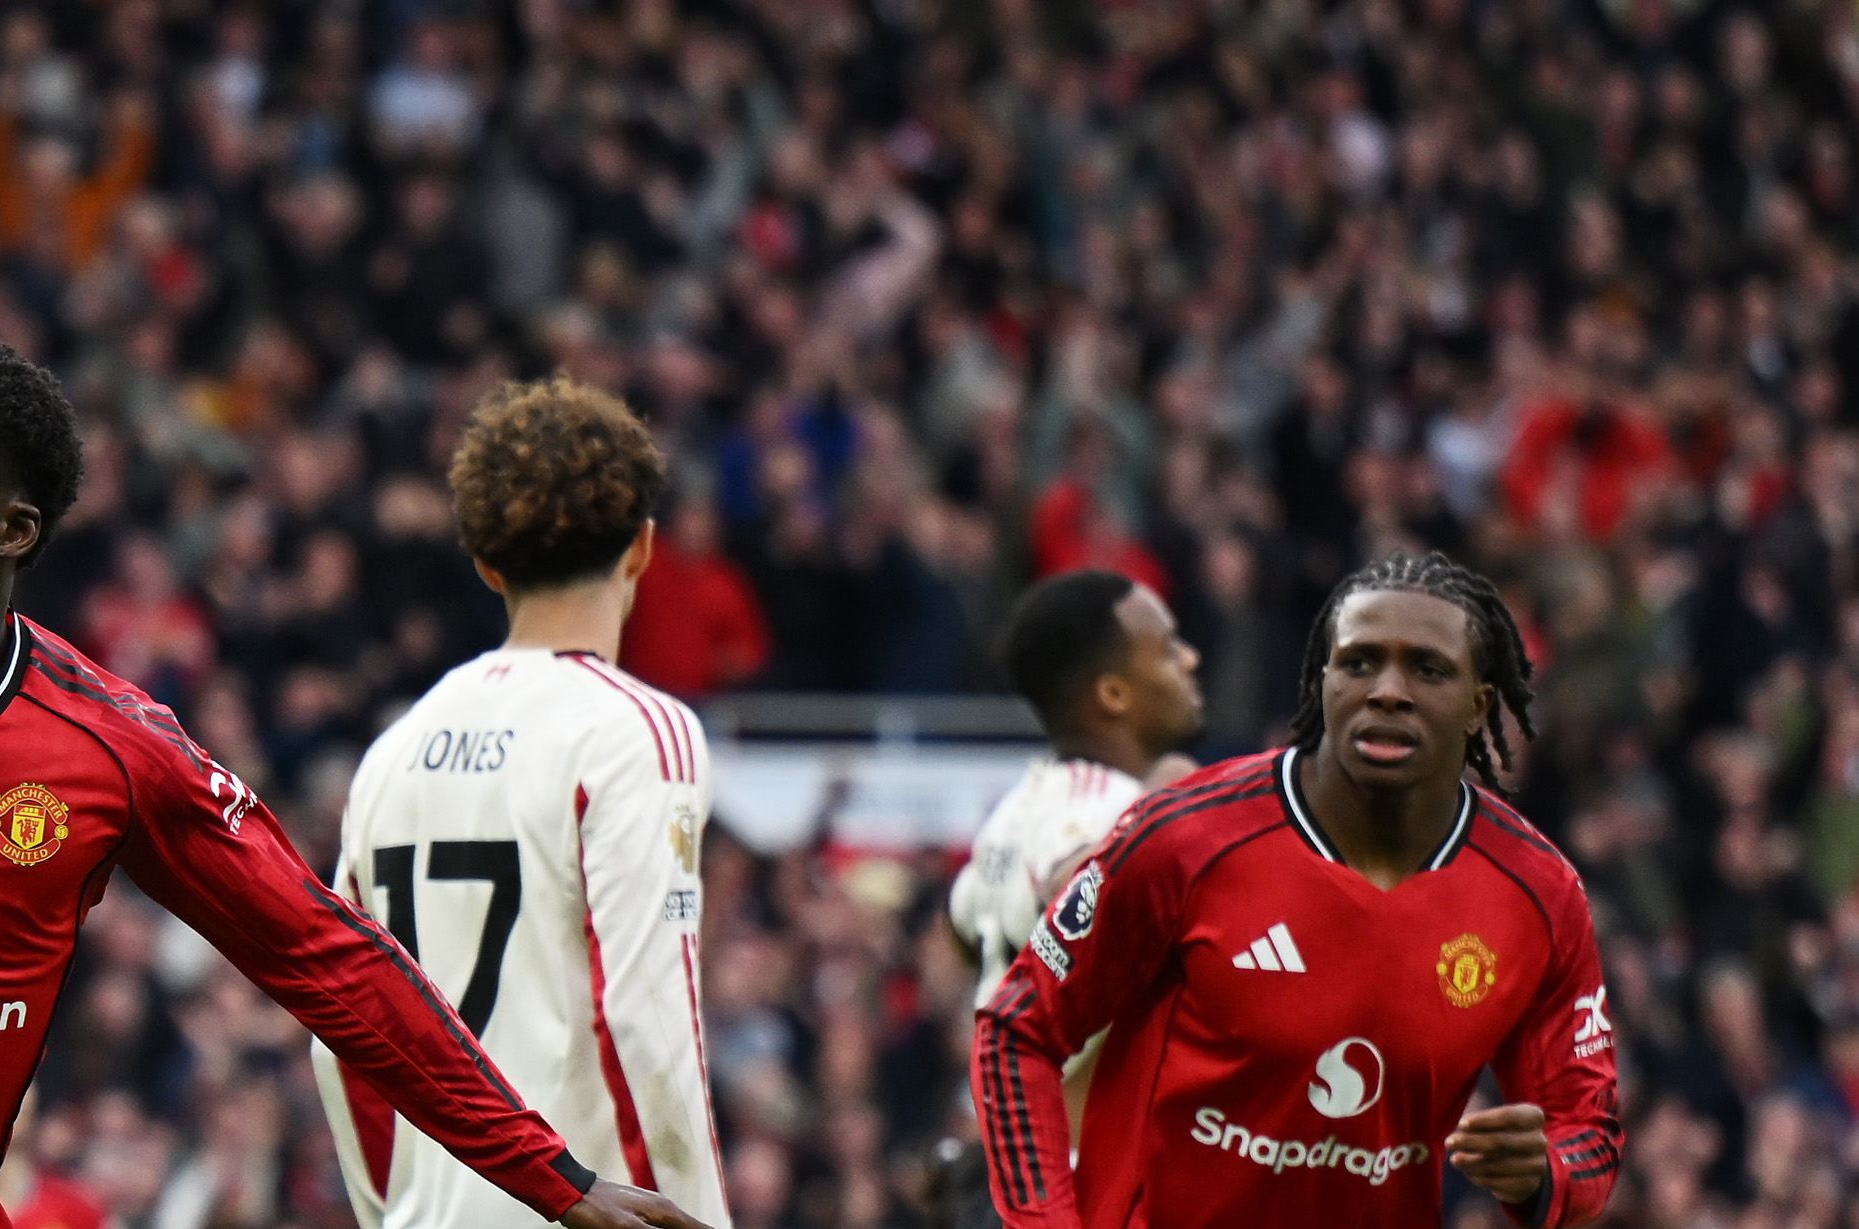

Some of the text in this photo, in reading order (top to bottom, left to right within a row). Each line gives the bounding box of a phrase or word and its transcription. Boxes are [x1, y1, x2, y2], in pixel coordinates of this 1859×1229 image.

[406, 729, 515, 774] JONES
[2, 844, 48, 860] UNITED
[372, 840, 522, 1043] 17
[1191, 1107, 1429, 1186] Snapdragon
